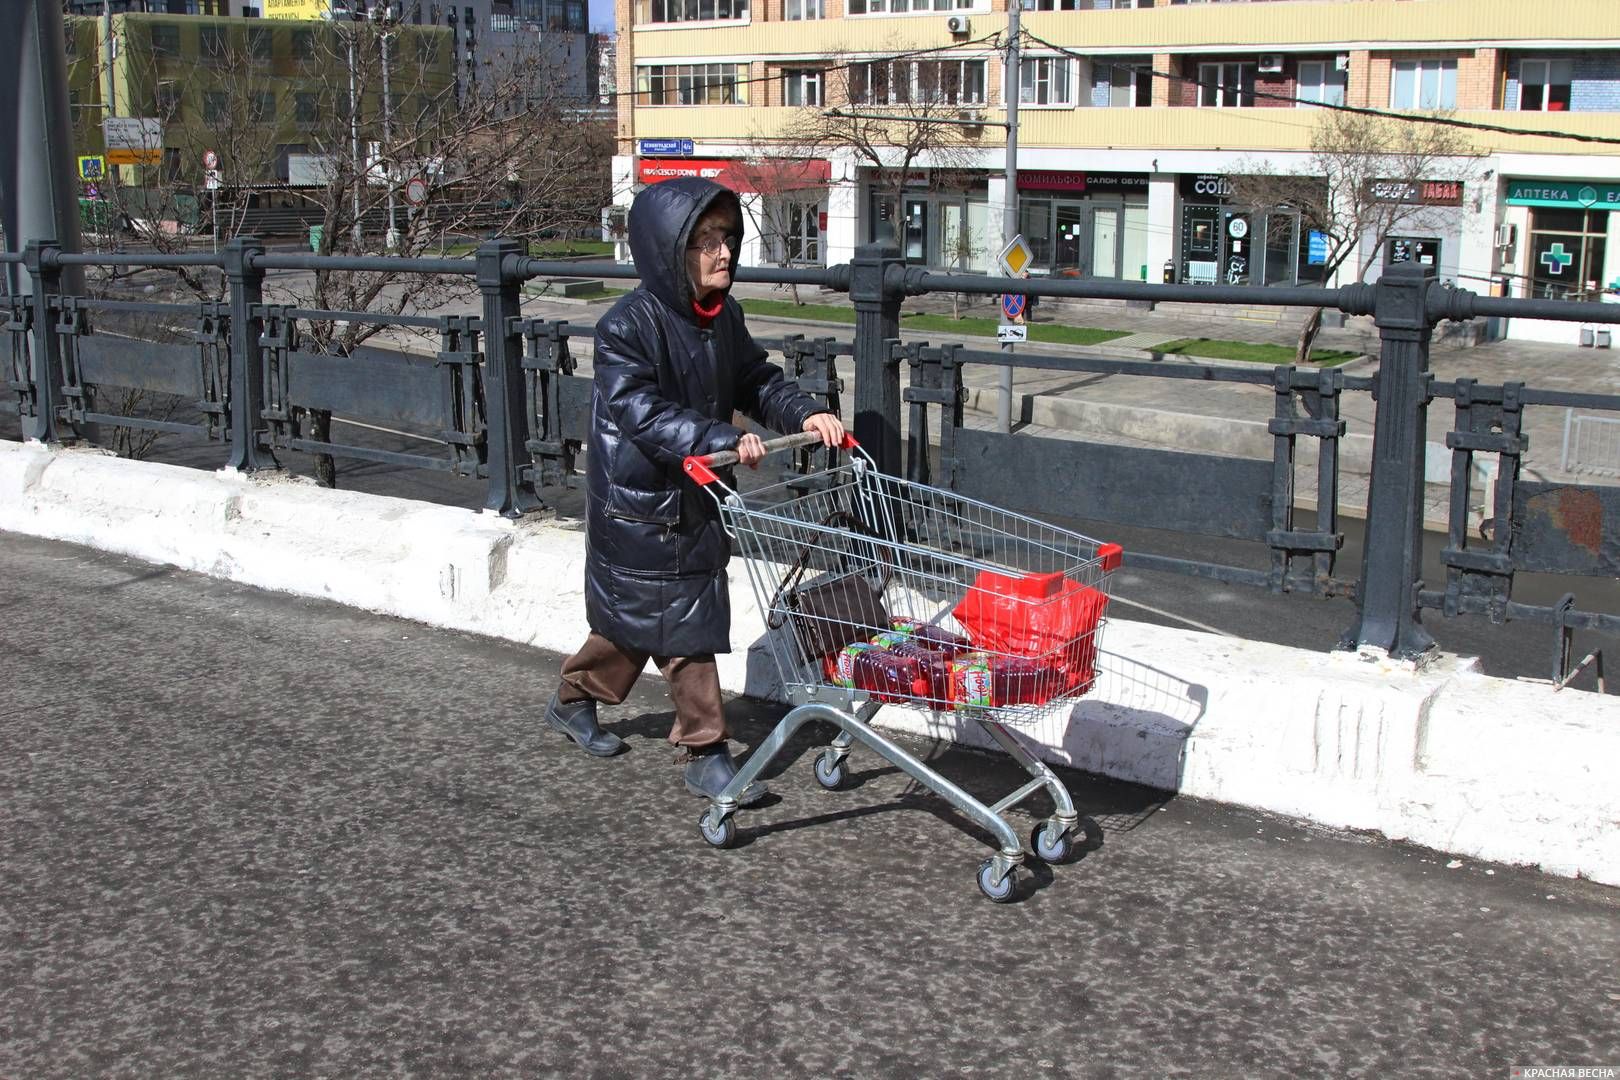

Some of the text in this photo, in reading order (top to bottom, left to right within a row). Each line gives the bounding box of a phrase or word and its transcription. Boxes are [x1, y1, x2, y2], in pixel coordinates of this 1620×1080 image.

[1018, 174, 1081, 185] КОМИЛЬФО
[1195, 178, 1237, 195] cofix
[1514, 188, 1569, 200] АПТЕКА
